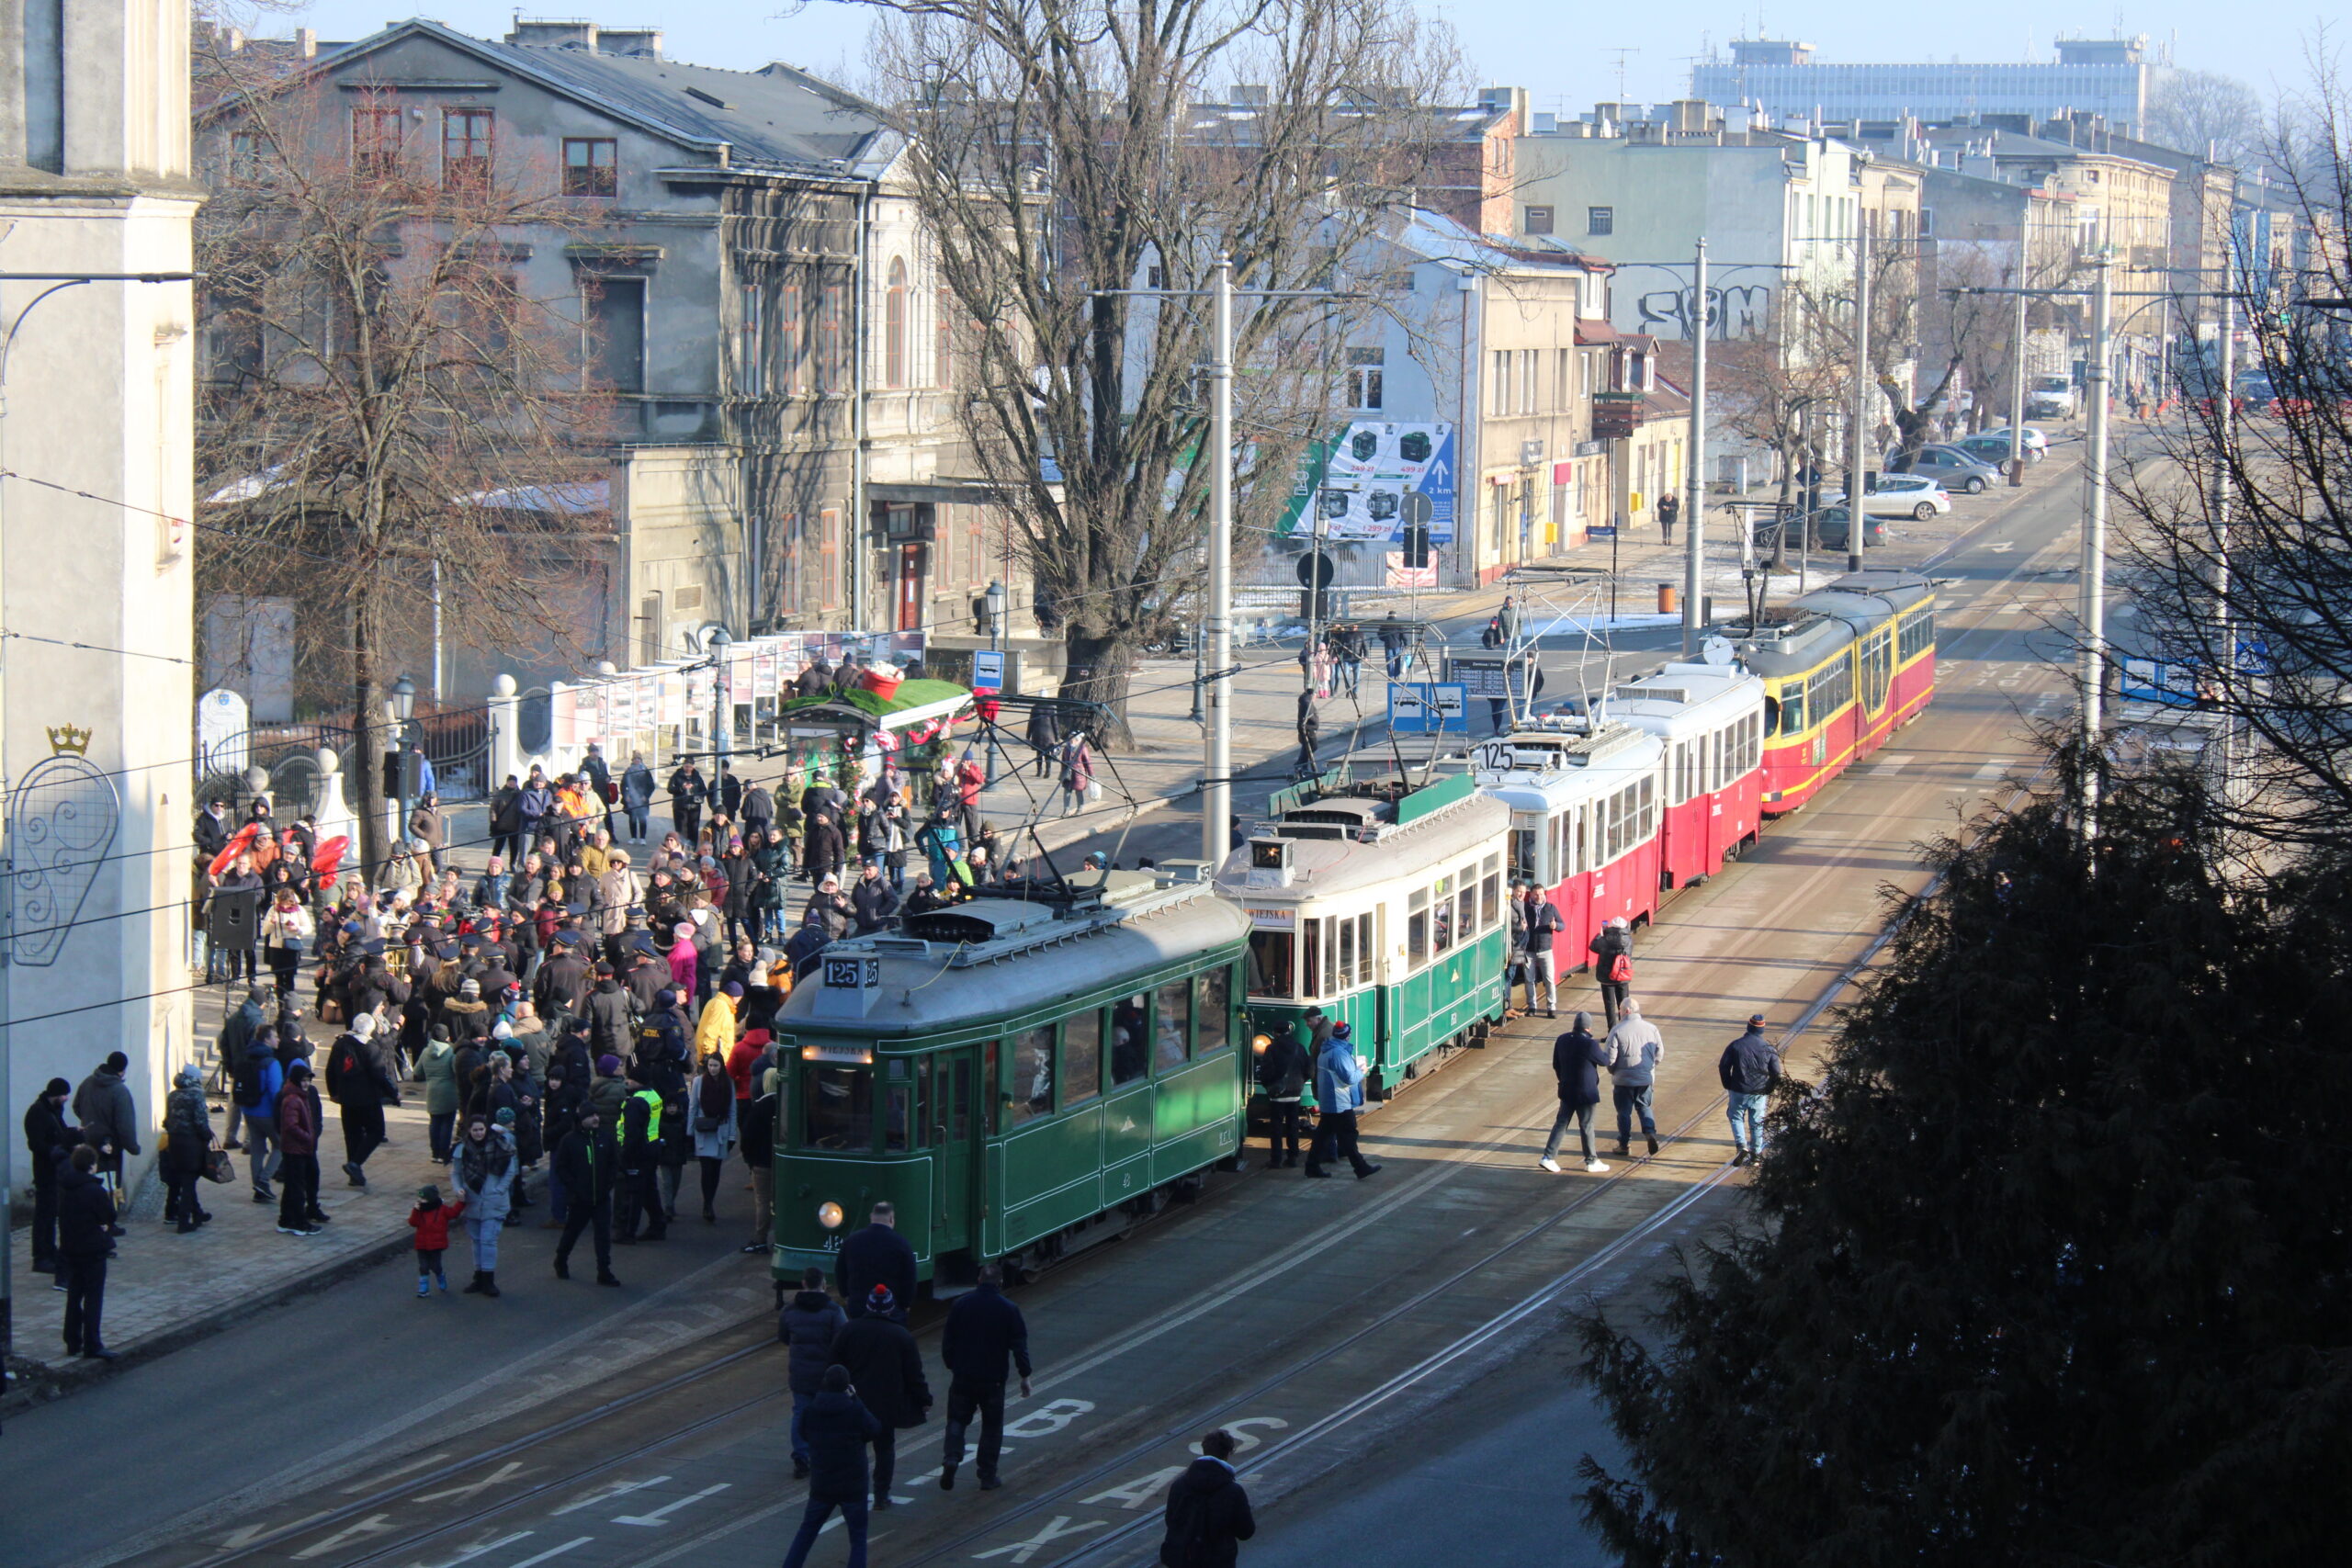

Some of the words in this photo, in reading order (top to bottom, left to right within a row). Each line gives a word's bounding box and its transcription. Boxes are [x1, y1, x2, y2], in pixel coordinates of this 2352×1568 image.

[1482, 742, 1513, 771] 125
[1255, 846, 1280, 864] 125
[1250, 908, 1286, 919] WIEJSKA
[827, 962, 858, 984] 125
[865, 962, 878, 985] 125
